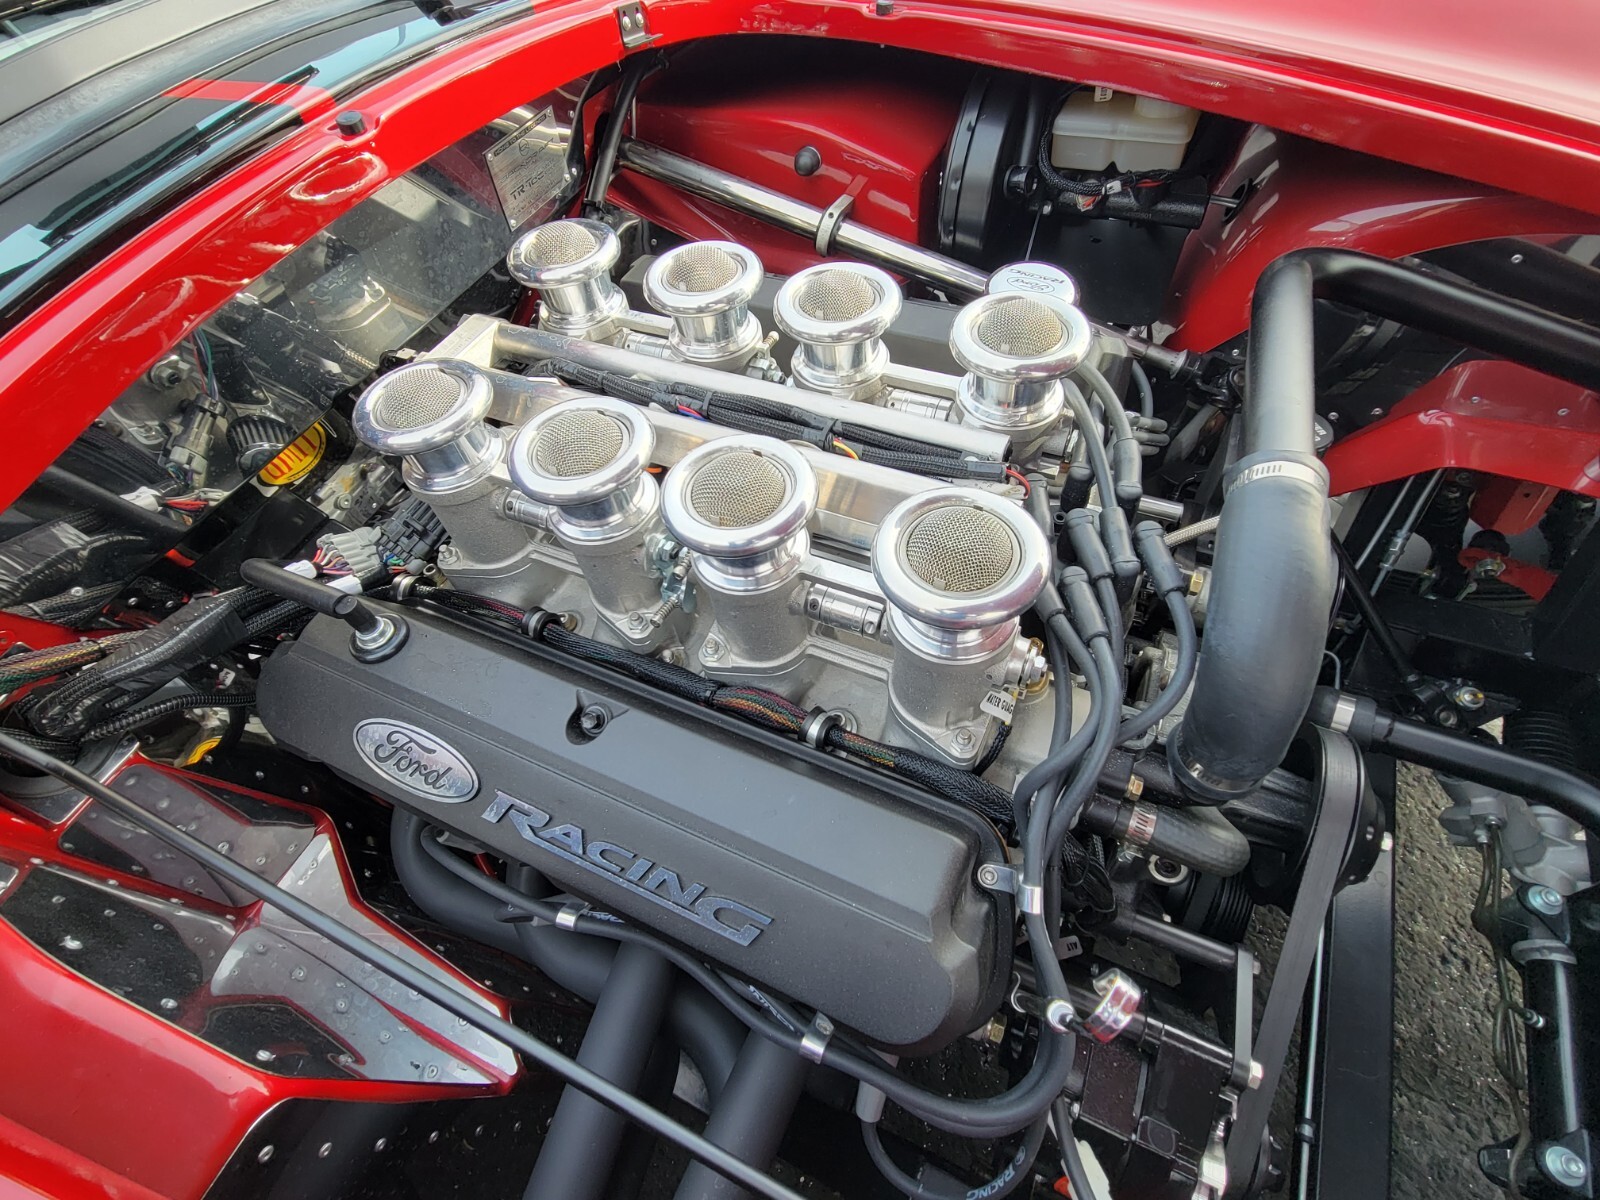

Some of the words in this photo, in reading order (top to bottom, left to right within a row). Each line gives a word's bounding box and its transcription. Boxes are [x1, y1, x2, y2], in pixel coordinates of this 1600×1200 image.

[1008, 268, 1066, 284] RACING
[373, 729, 454, 790] Ford
[480, 788, 775, 947] RACING
[966, 1163, 1015, 1200] RACING
